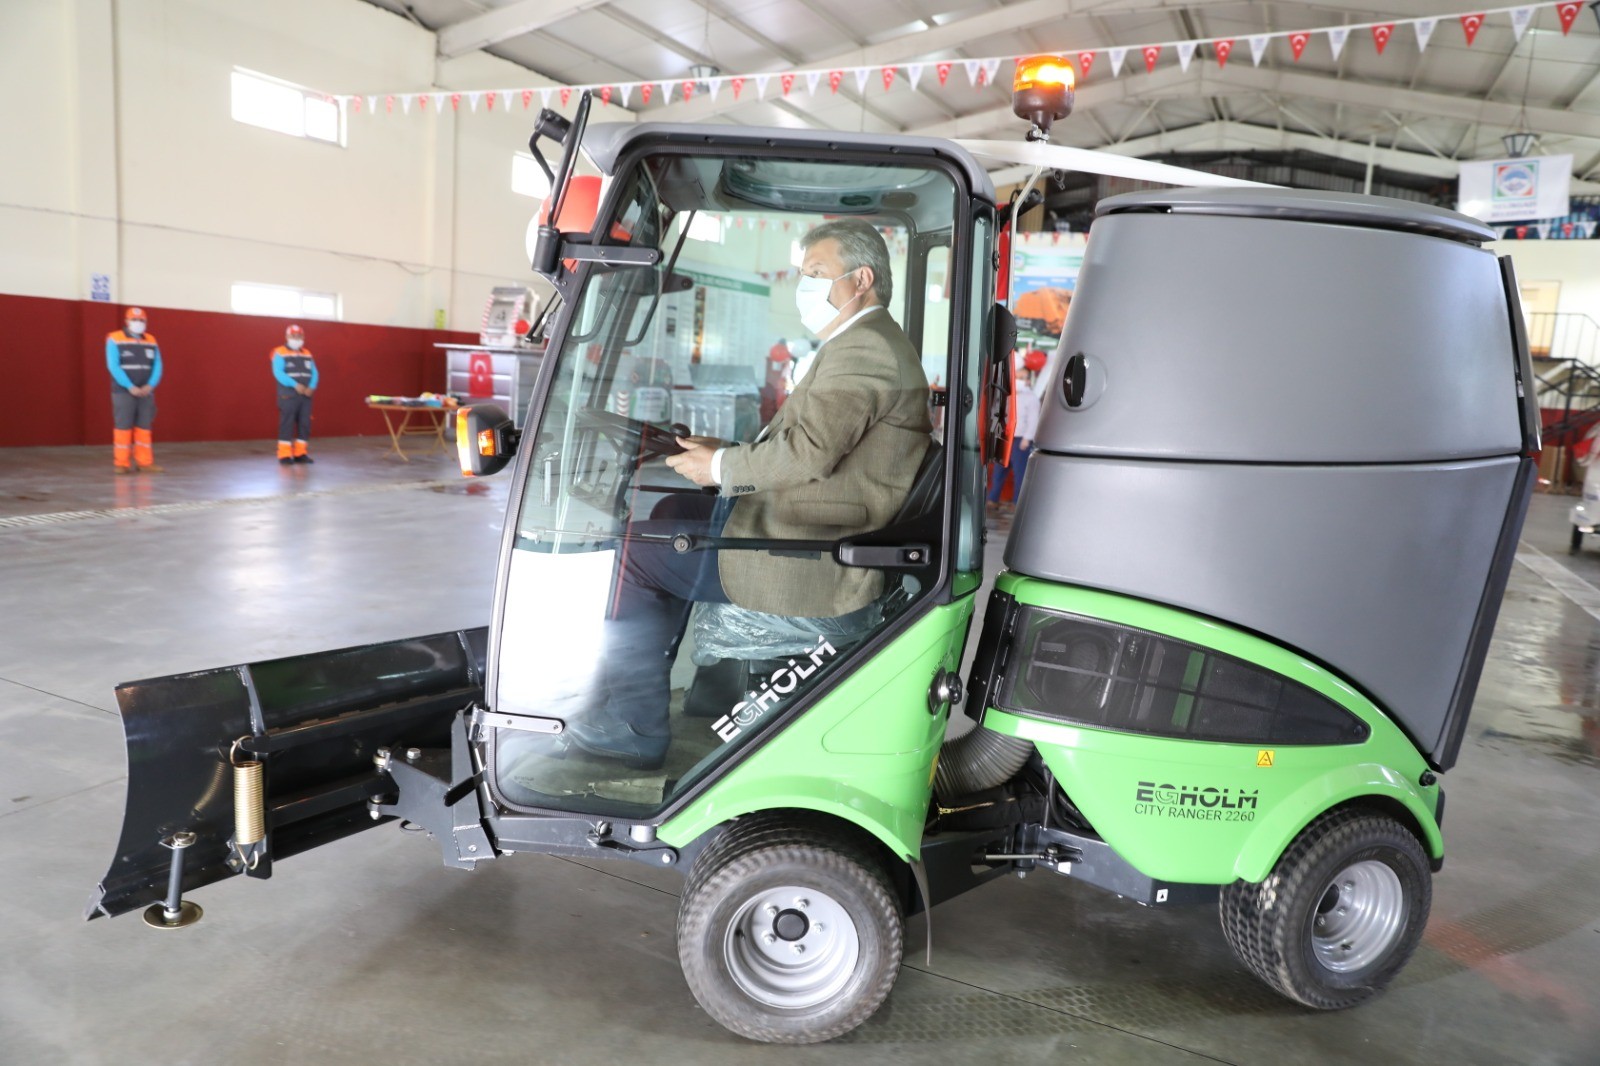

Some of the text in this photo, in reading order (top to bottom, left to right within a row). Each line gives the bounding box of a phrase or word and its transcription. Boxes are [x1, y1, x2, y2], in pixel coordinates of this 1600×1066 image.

[710, 634, 837, 743] EGHOLM
[1136, 781, 1258, 808] EGHOLM
[1134, 803, 1255, 822] CITY RANGER 2260
